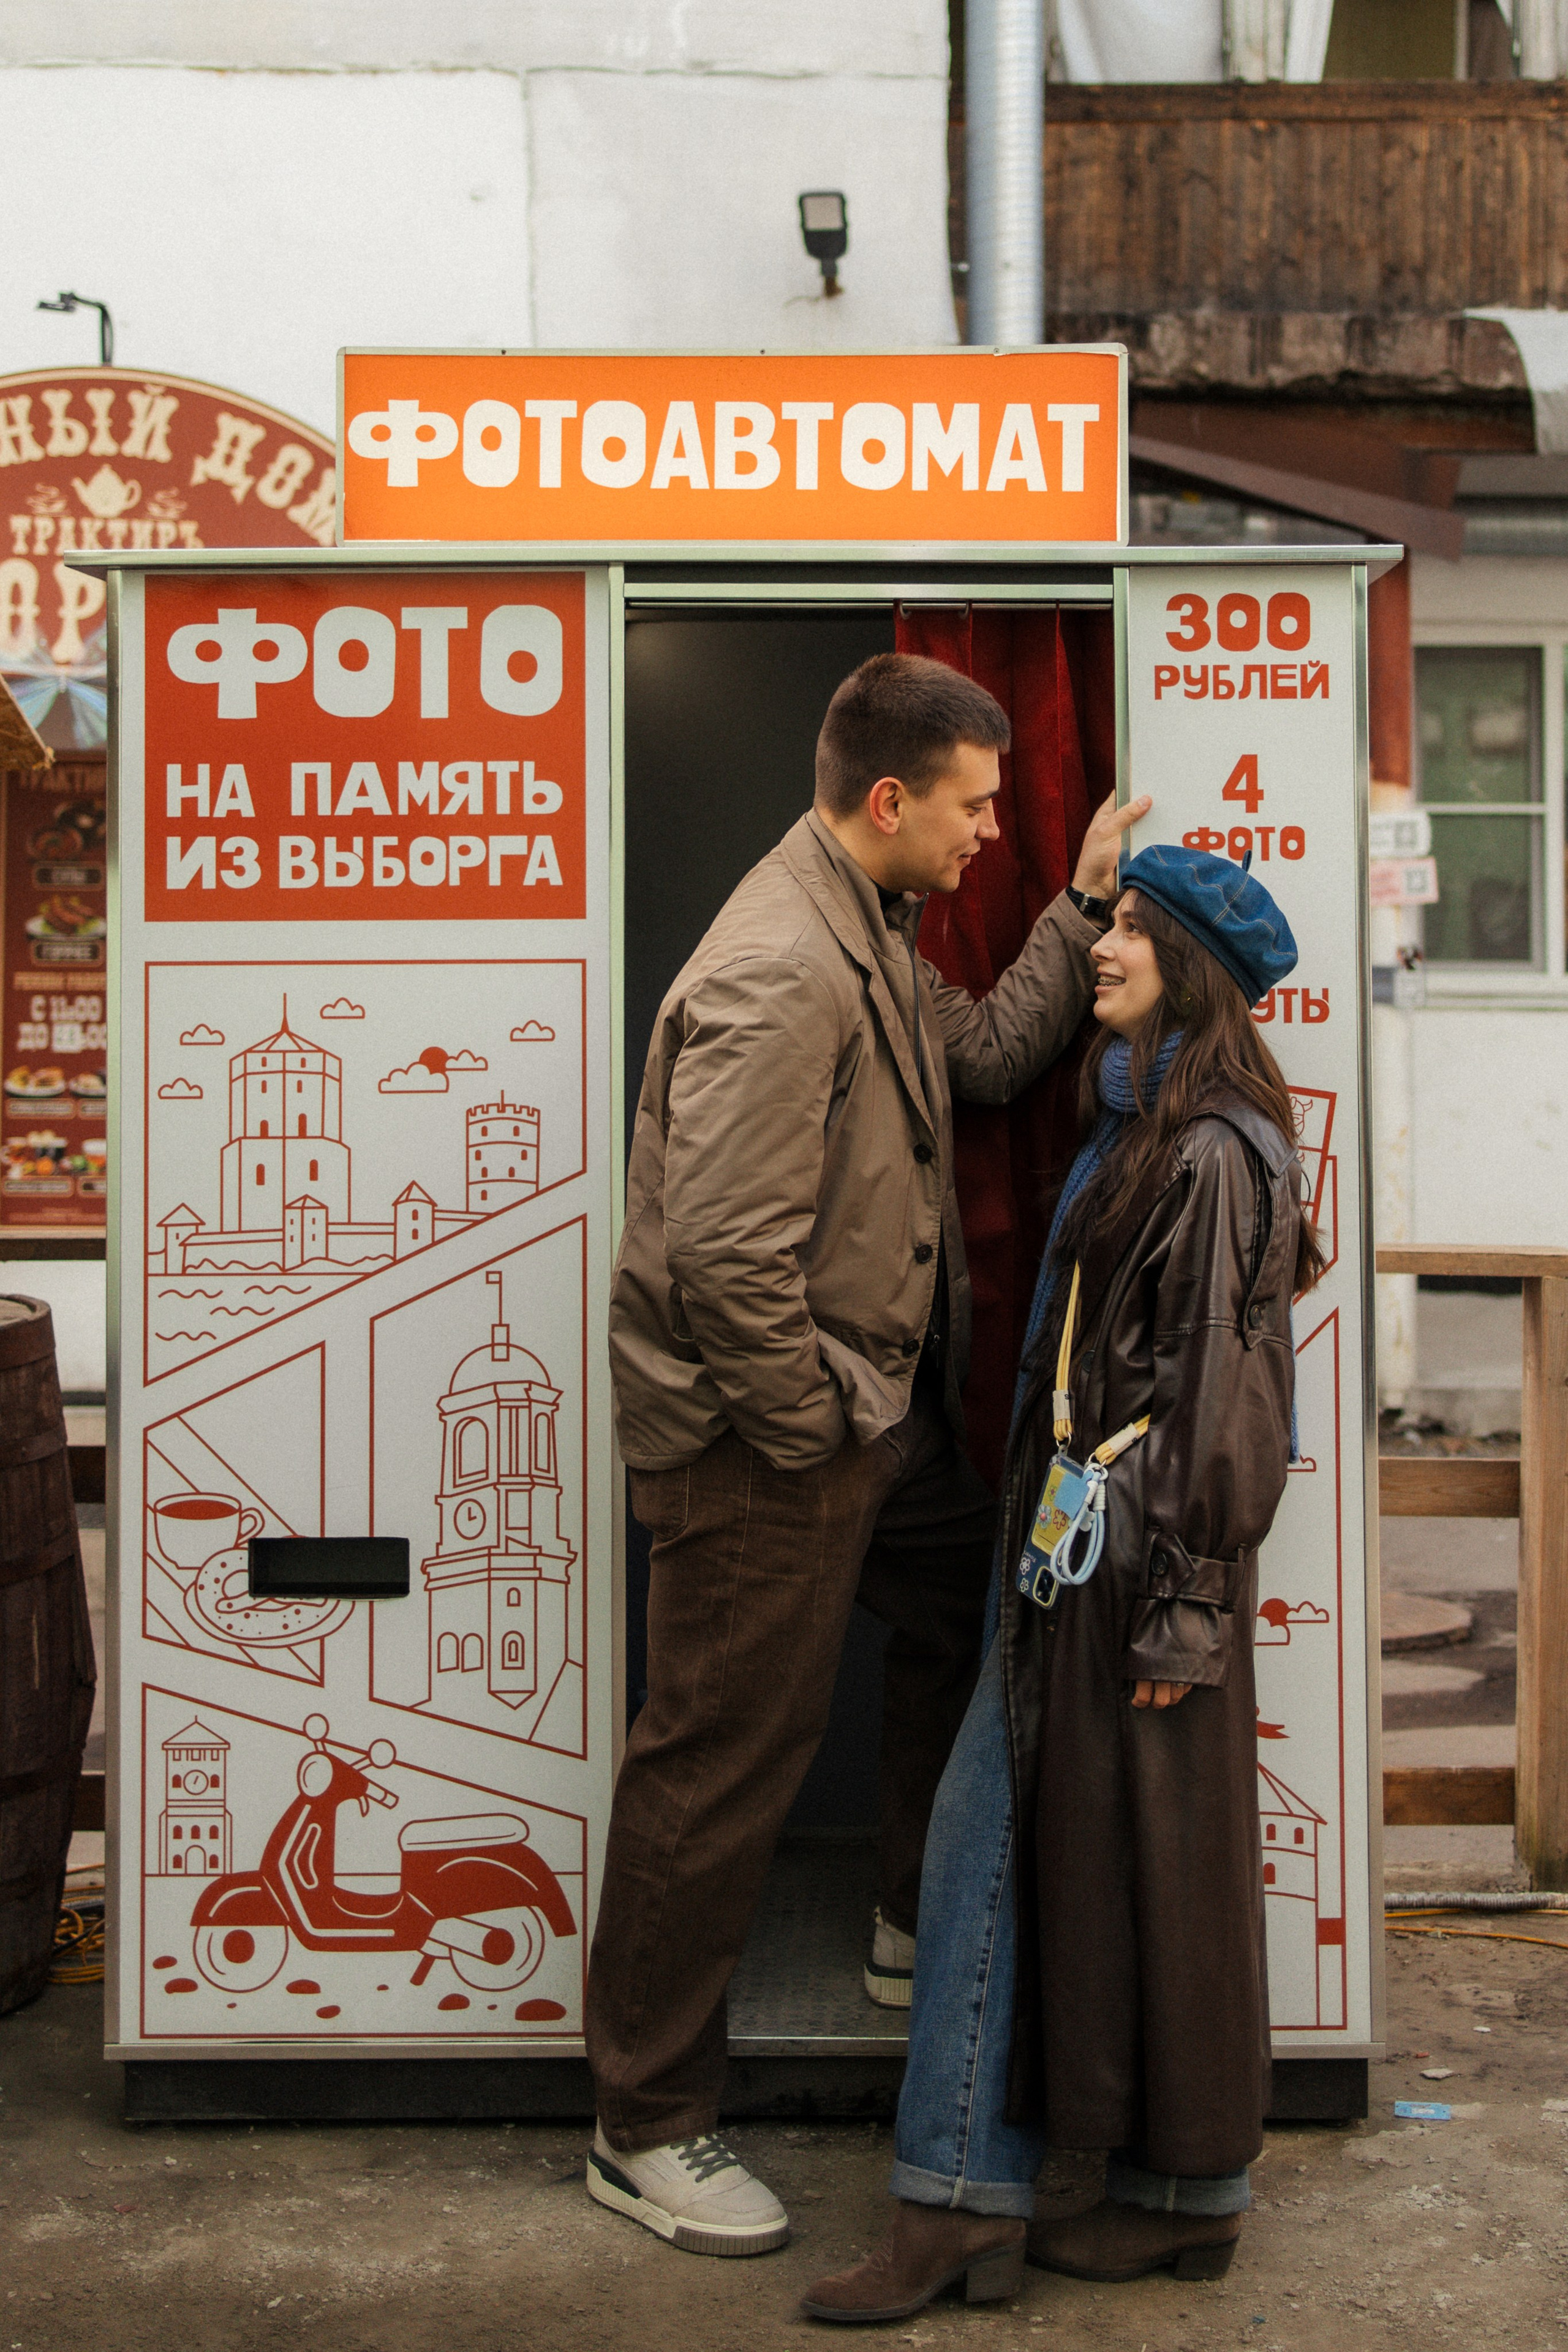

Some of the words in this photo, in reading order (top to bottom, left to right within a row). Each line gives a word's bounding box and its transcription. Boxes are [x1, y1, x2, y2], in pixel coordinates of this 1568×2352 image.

[347, 399, 1101, 492] ФОТОАВТОМАТ
[1166, 592, 1311, 652] 300
[167, 604, 563, 720] ФОТО
[1154, 660, 1330, 700] РУБЛЕЙ
[166, 763, 255, 818] НА
[291, 760, 564, 816] ПАМЯТЬ
[1222, 753, 1264, 814] 4
[166, 835, 262, 890] ИЗ
[279, 835, 564, 889] ВЫБОРГА
[1182, 825, 1305, 861] ФОТО
